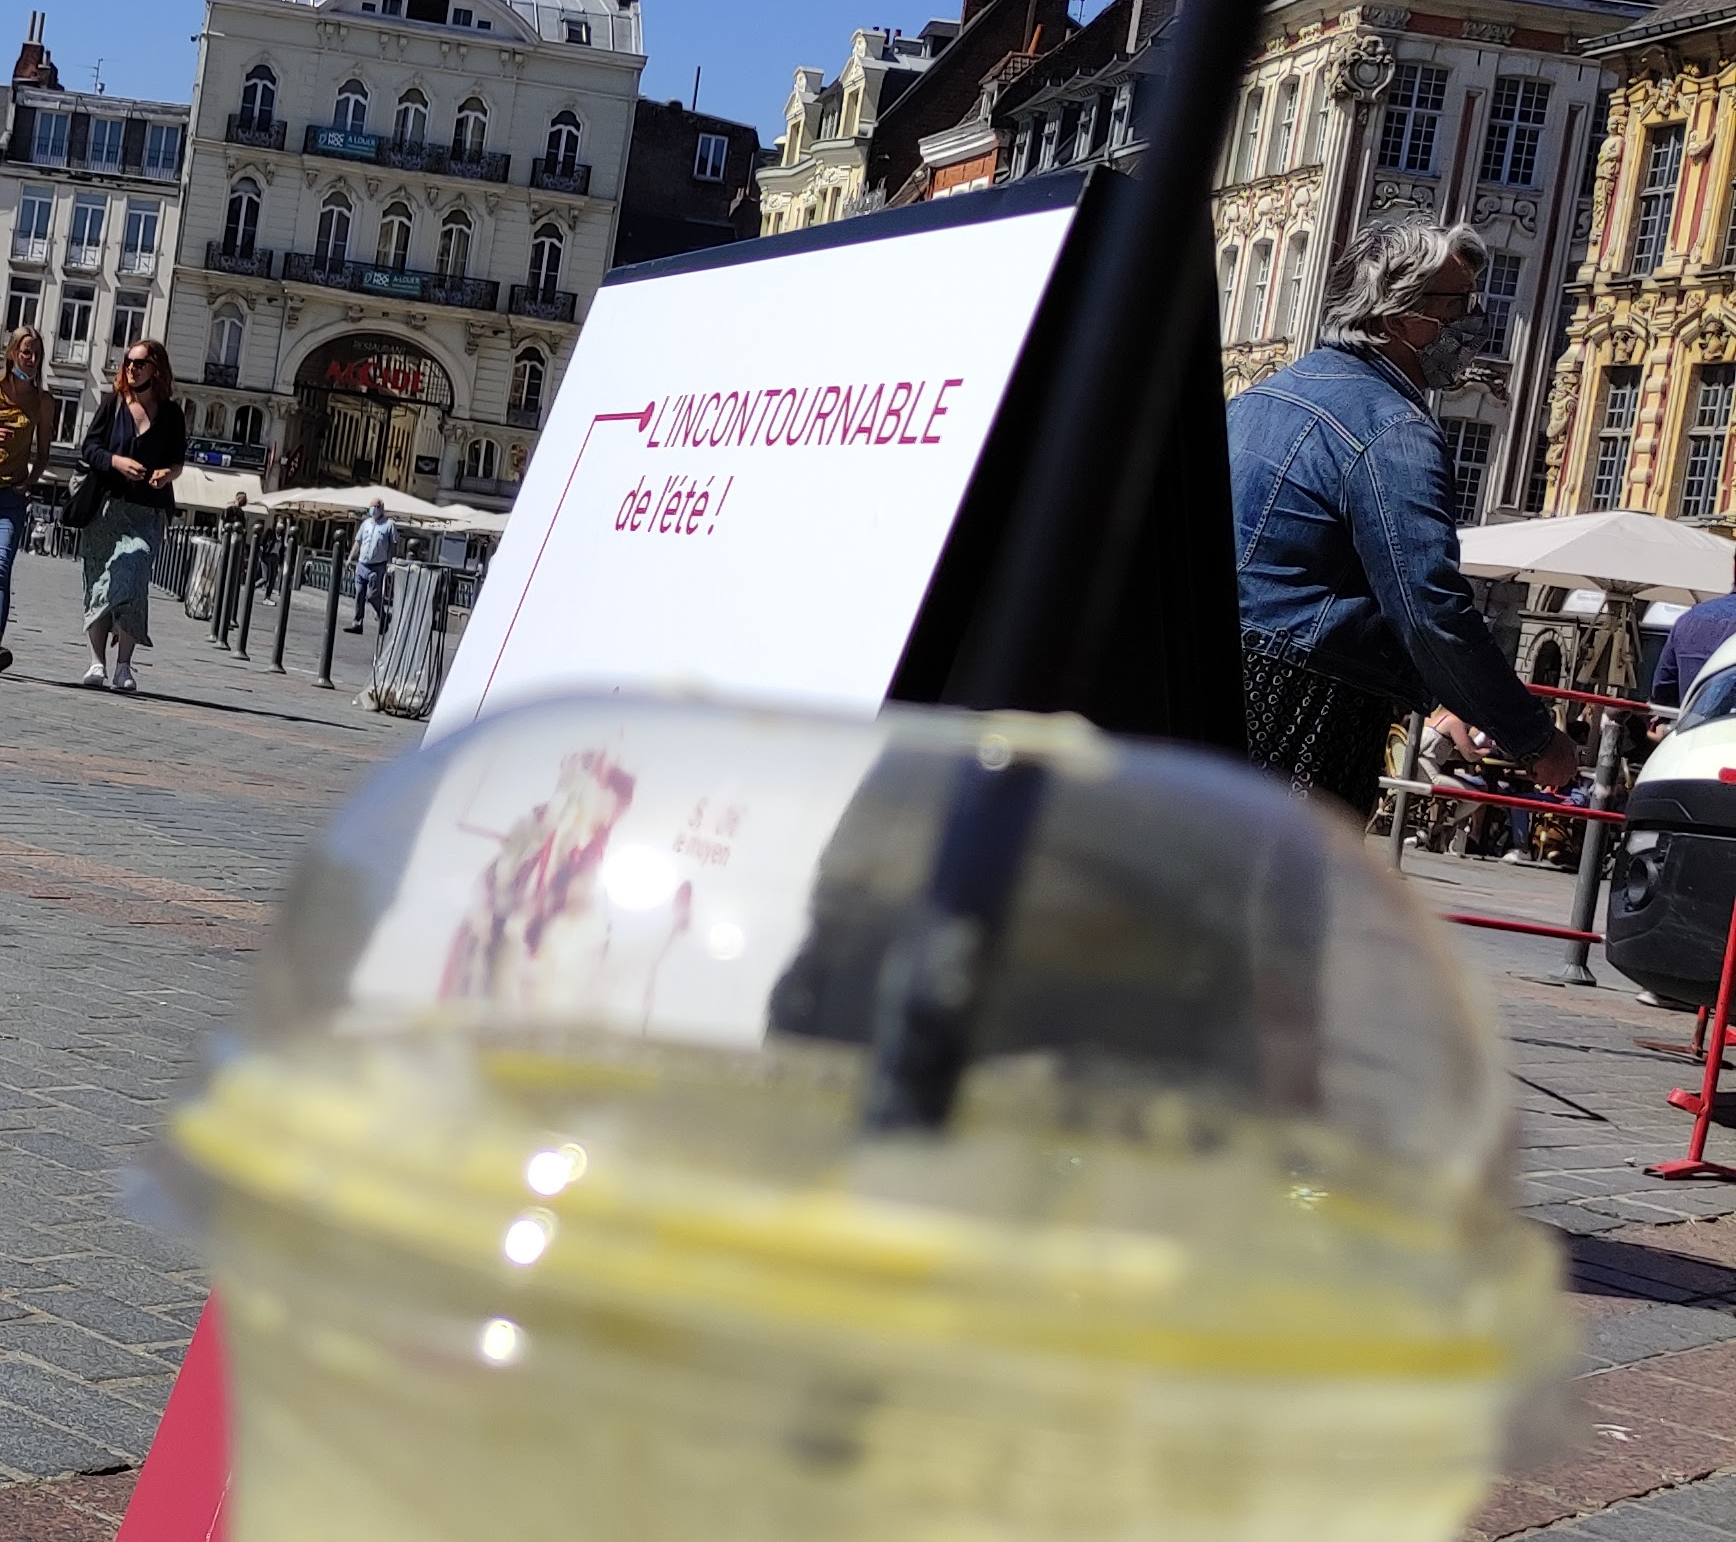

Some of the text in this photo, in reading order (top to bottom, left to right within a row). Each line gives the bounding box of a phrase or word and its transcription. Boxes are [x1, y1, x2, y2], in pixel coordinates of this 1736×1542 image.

[353, 339, 407, 355] RESTAURANT
[646, 377, 965, 448] L'INCONTOURNABLE
[614, 474, 652, 533] de
[647, 474, 716, 536] l'été
